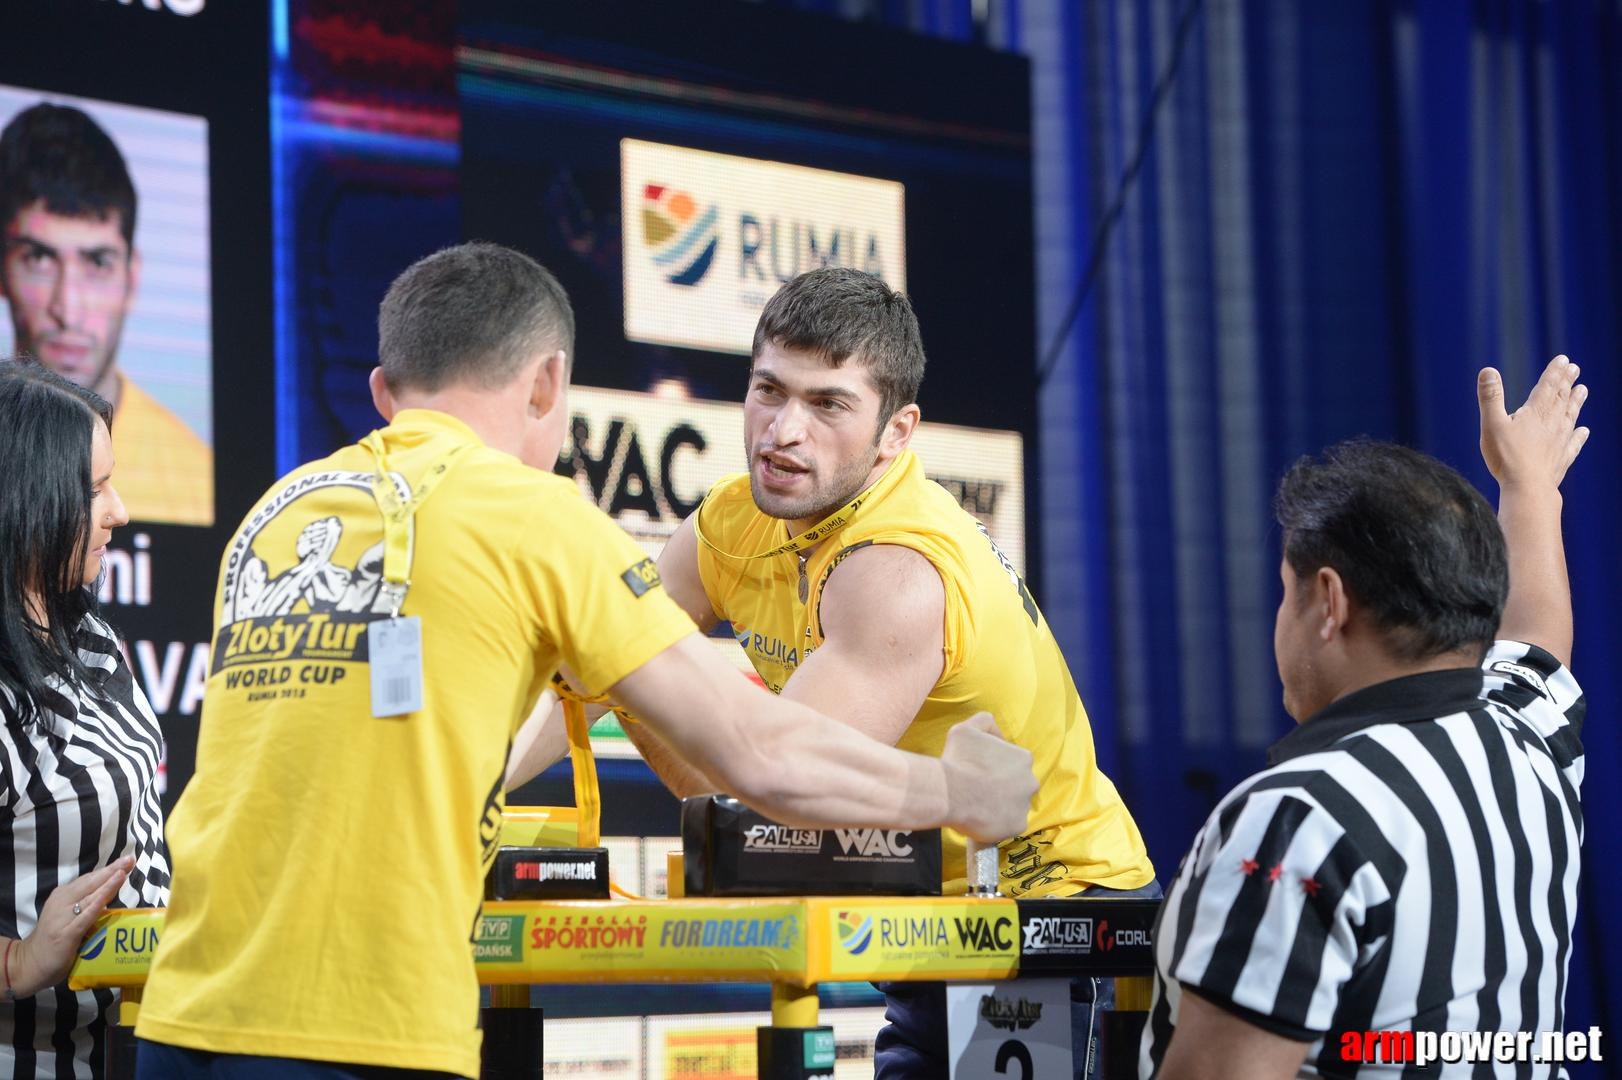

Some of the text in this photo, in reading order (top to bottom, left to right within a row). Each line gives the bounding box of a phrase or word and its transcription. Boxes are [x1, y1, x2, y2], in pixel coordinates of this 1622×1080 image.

[818, 516, 846, 535] RUMIA
[225, 665, 346, 690] WORLD CUP
[834, 828, 912, 857] WAC
[515, 861, 596, 882] armpower.net
[531, 927, 648, 949] SPORTOWY
[881, 917, 950, 947] RUMIA
[954, 917, 1013, 951] WAC
